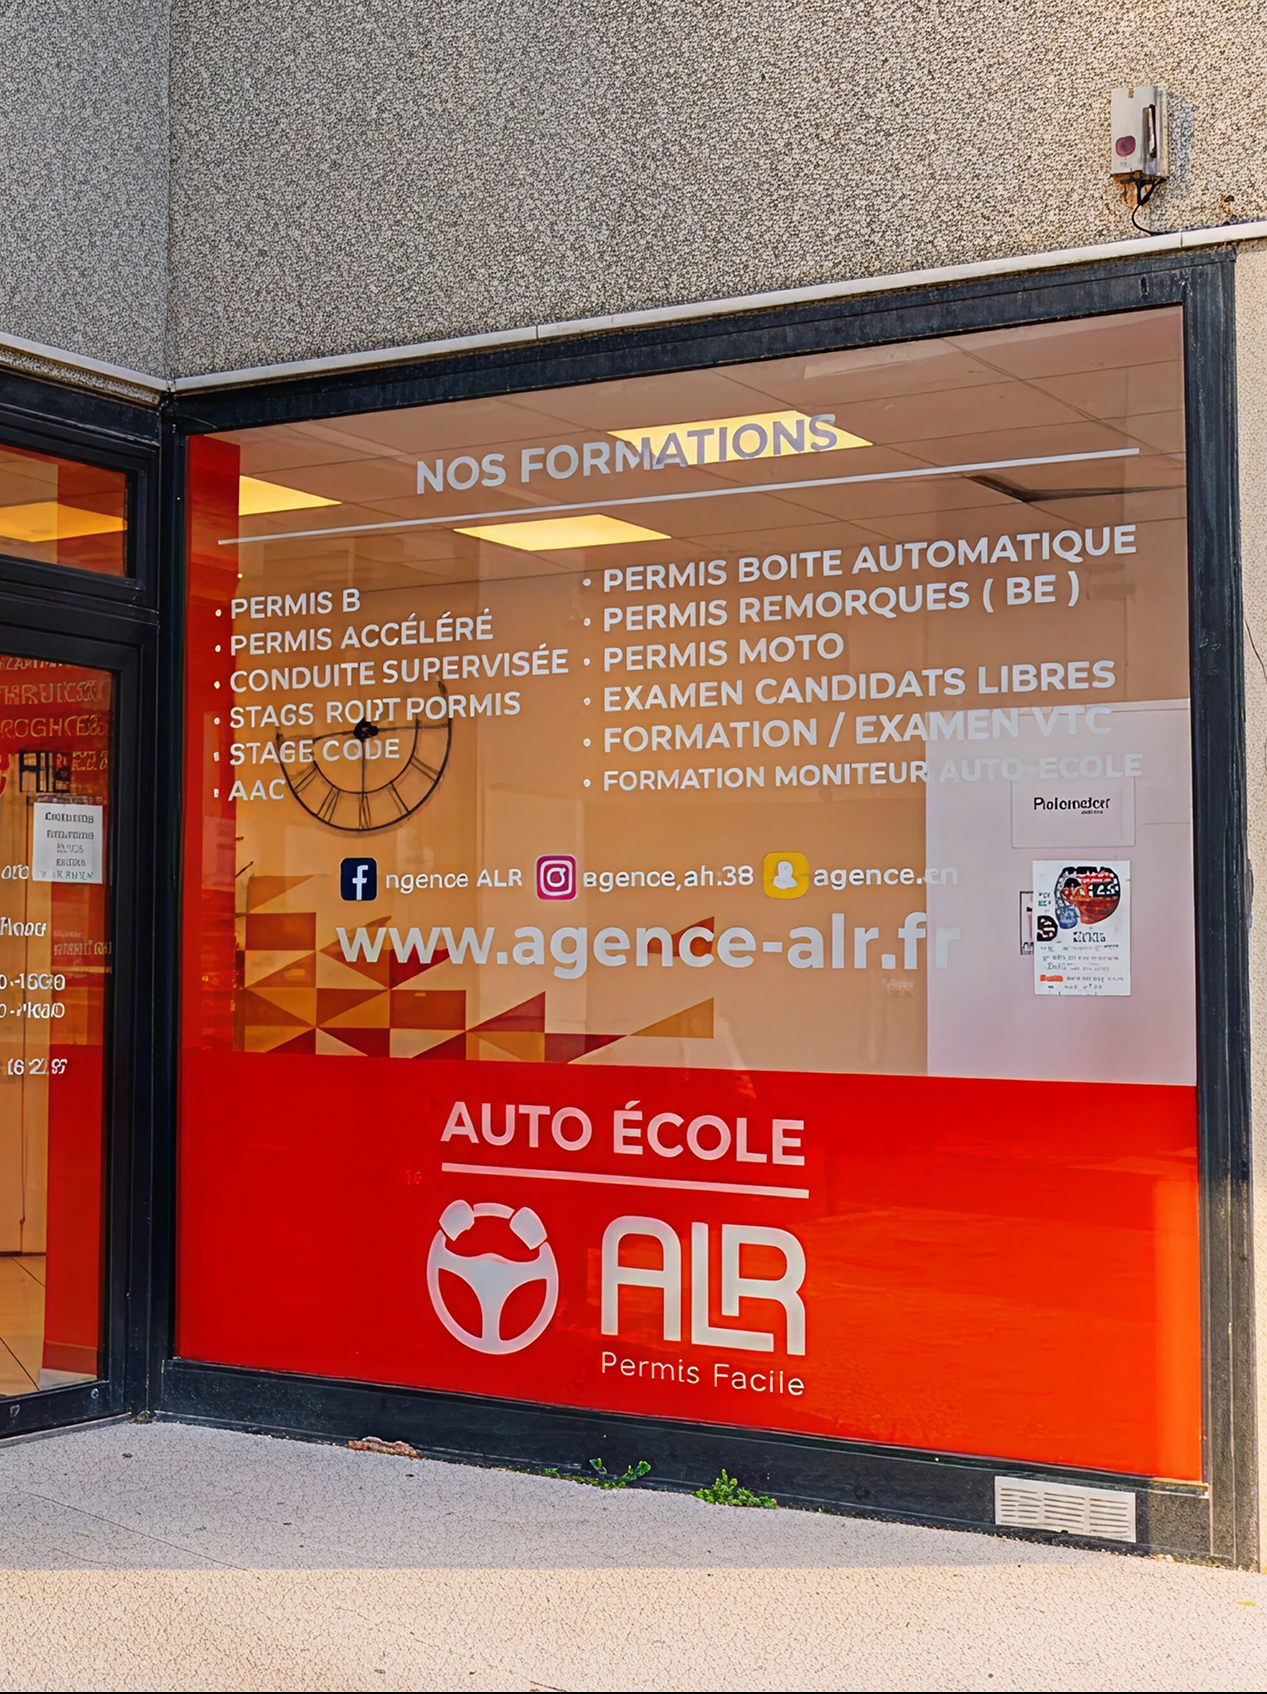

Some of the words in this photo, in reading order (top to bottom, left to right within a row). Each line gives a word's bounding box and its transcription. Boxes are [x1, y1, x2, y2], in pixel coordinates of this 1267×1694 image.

[417, 453, 506, 494] NOS
[521, 414, 837, 482] FORMATIONS
[603, 559, 728, 593] PERMIS
[738, 549, 842, 583] BOITE
[851, 524, 1137, 575] AUTOMATIQUE
[231, 590, 333, 619] PERMIS
[343, 588, 361, 612] B
[603, 599, 728, 632] PERMIS
[739, 581, 971, 623] REMORQUES
[231, 628, 332, 656] PERMIS
[341, 608, 493, 649] ACCÉLÉRÉ
[603, 639, 728, 673] PERMIS
[739, 632, 844, 664] MOTO
[229, 661, 375, 693] CONDUITE
[382, 642, 569, 683] SUPERVISÉE
[603, 679, 743, 713] EXAMEN
[755, 667, 966, 704] CANDIDATS
[978, 660, 1116, 695] LIBRES
[230, 739, 313, 766] STAGE
[322, 738, 400, 762] CODE
[604, 717, 817, 753] FORMATION
[855, 708, 1019, 745] EXAMEN
[1032, 706, 1112, 737] VTC
[228, 778, 285, 802] AAC
[603, 766, 765, 792] FORMATION
[775, 760, 930, 787] MONITEUR
[476, 868, 523, 888] ALR
[336, 911, 961, 980] www.agence-alr.fr
[440, 1101, 592, 1151] AUTO
[613, 1100, 805, 1166] ÉCOLE
[601, 1215, 806, 1356] ALR
[601, 1351, 700, 1384] Permis
[713, 1363, 805, 1396] Facile
